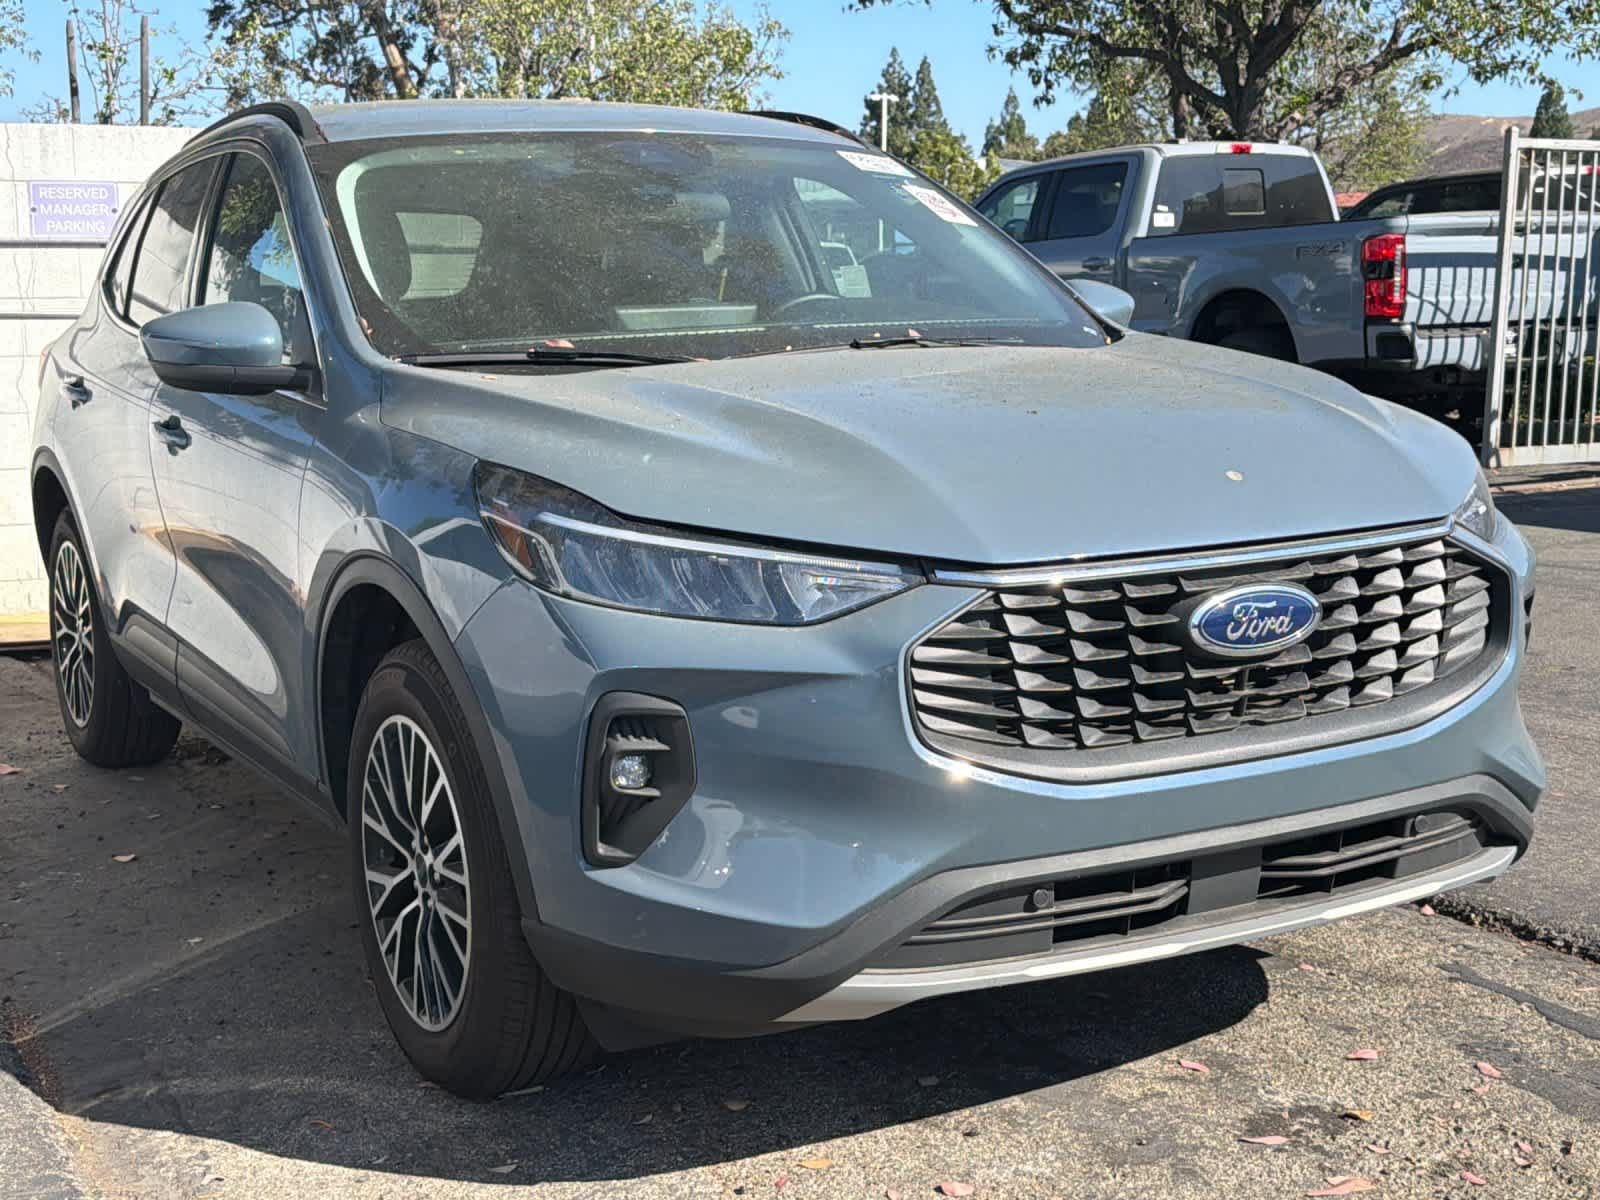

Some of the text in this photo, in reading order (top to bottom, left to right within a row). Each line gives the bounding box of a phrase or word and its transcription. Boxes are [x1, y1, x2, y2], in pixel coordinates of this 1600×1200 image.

[39, 186, 109, 200] RESERVED
[40, 203, 110, 217] MANAGER
[47, 219, 106, 233] PARKING
[1226, 600, 1295, 641] Ford
